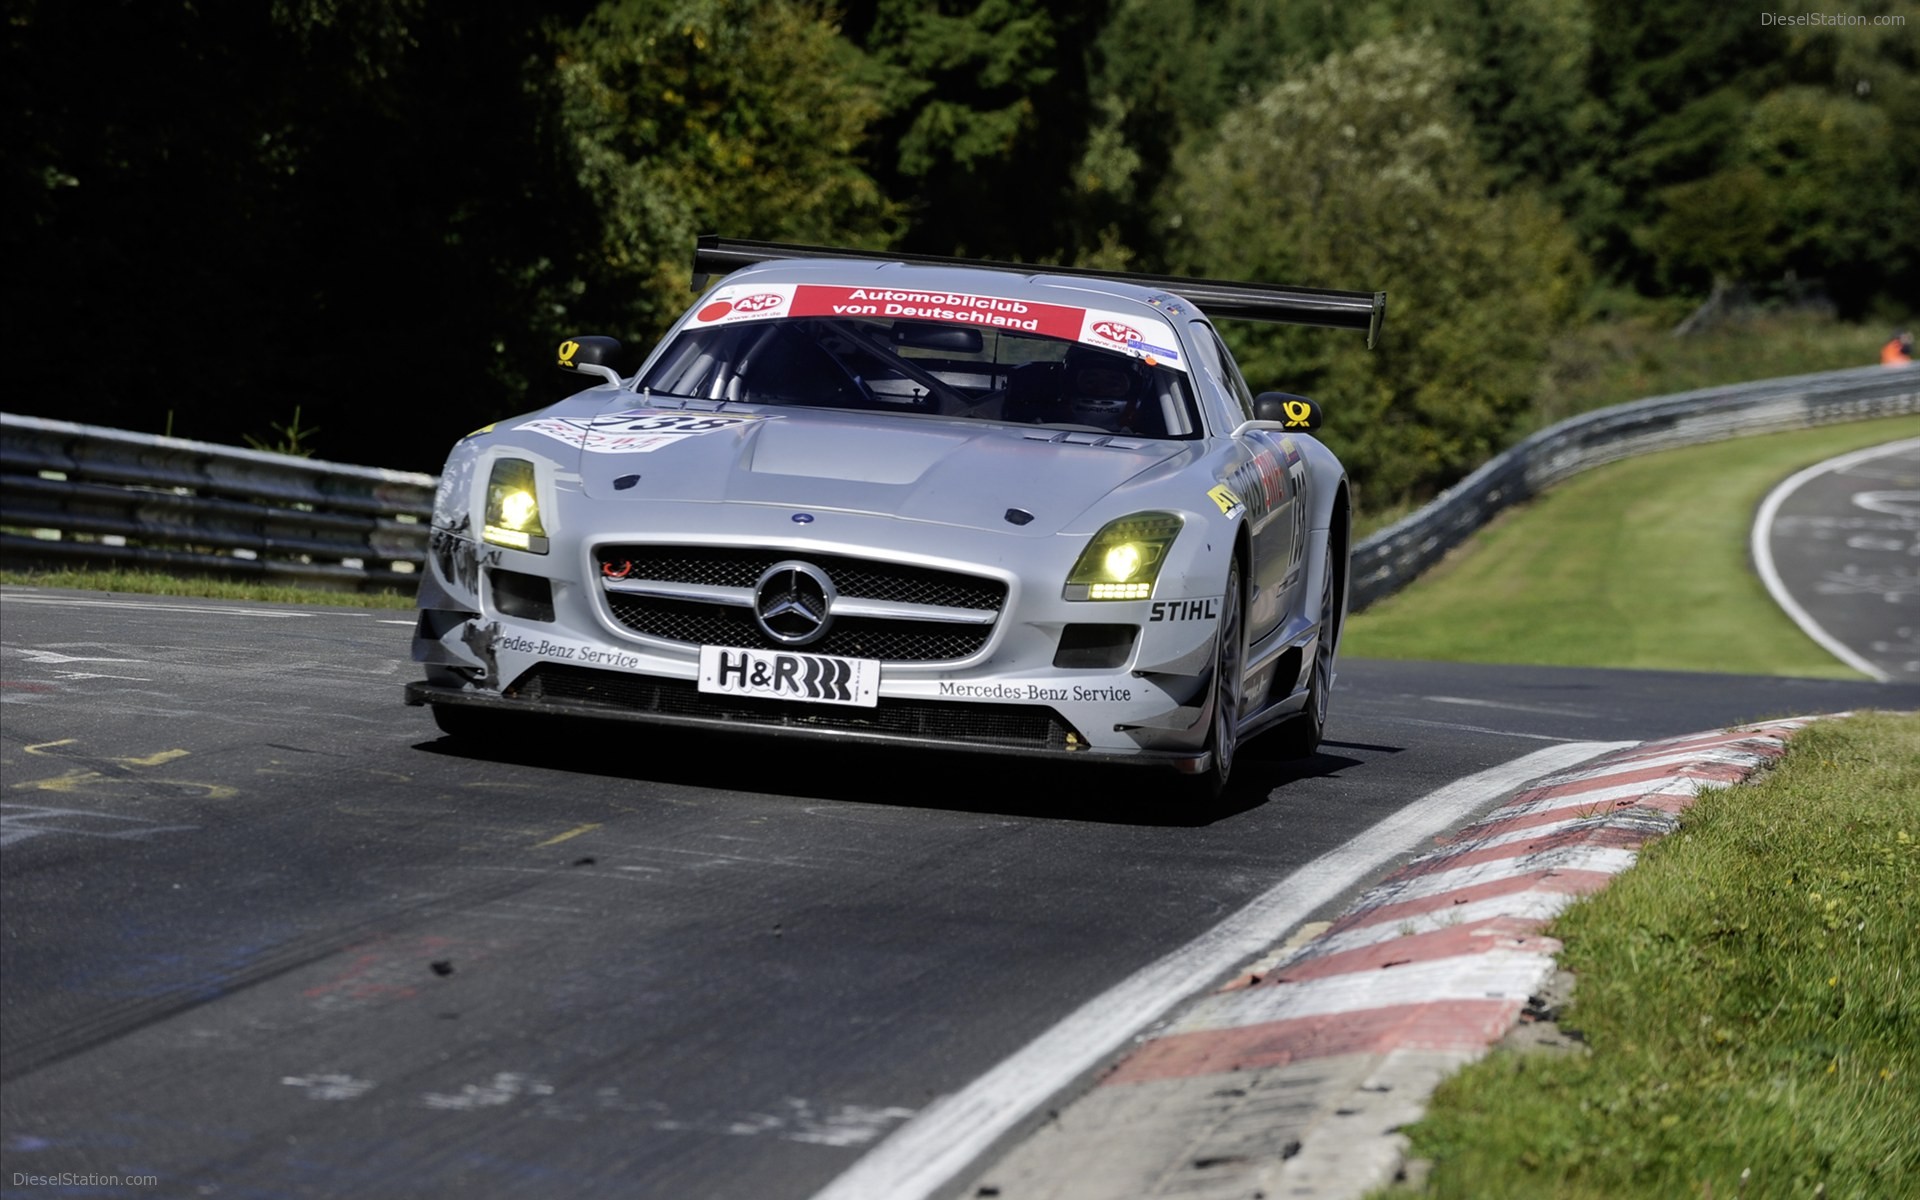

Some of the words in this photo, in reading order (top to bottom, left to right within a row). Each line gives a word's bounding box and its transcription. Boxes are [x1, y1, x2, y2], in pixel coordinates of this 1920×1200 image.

[848, 289, 1029, 314] Automobilclub
[832, 305, 877, 314] von
[884, 303, 1038, 331] Deutschland
[1149, 600, 1217, 622] STIHL
[578, 646, 639, 668] Service
[719, 651, 800, 693] H&R
[939, 682, 1068, 701] Mercedes-Benz
[1073, 685, 1132, 702] Service
